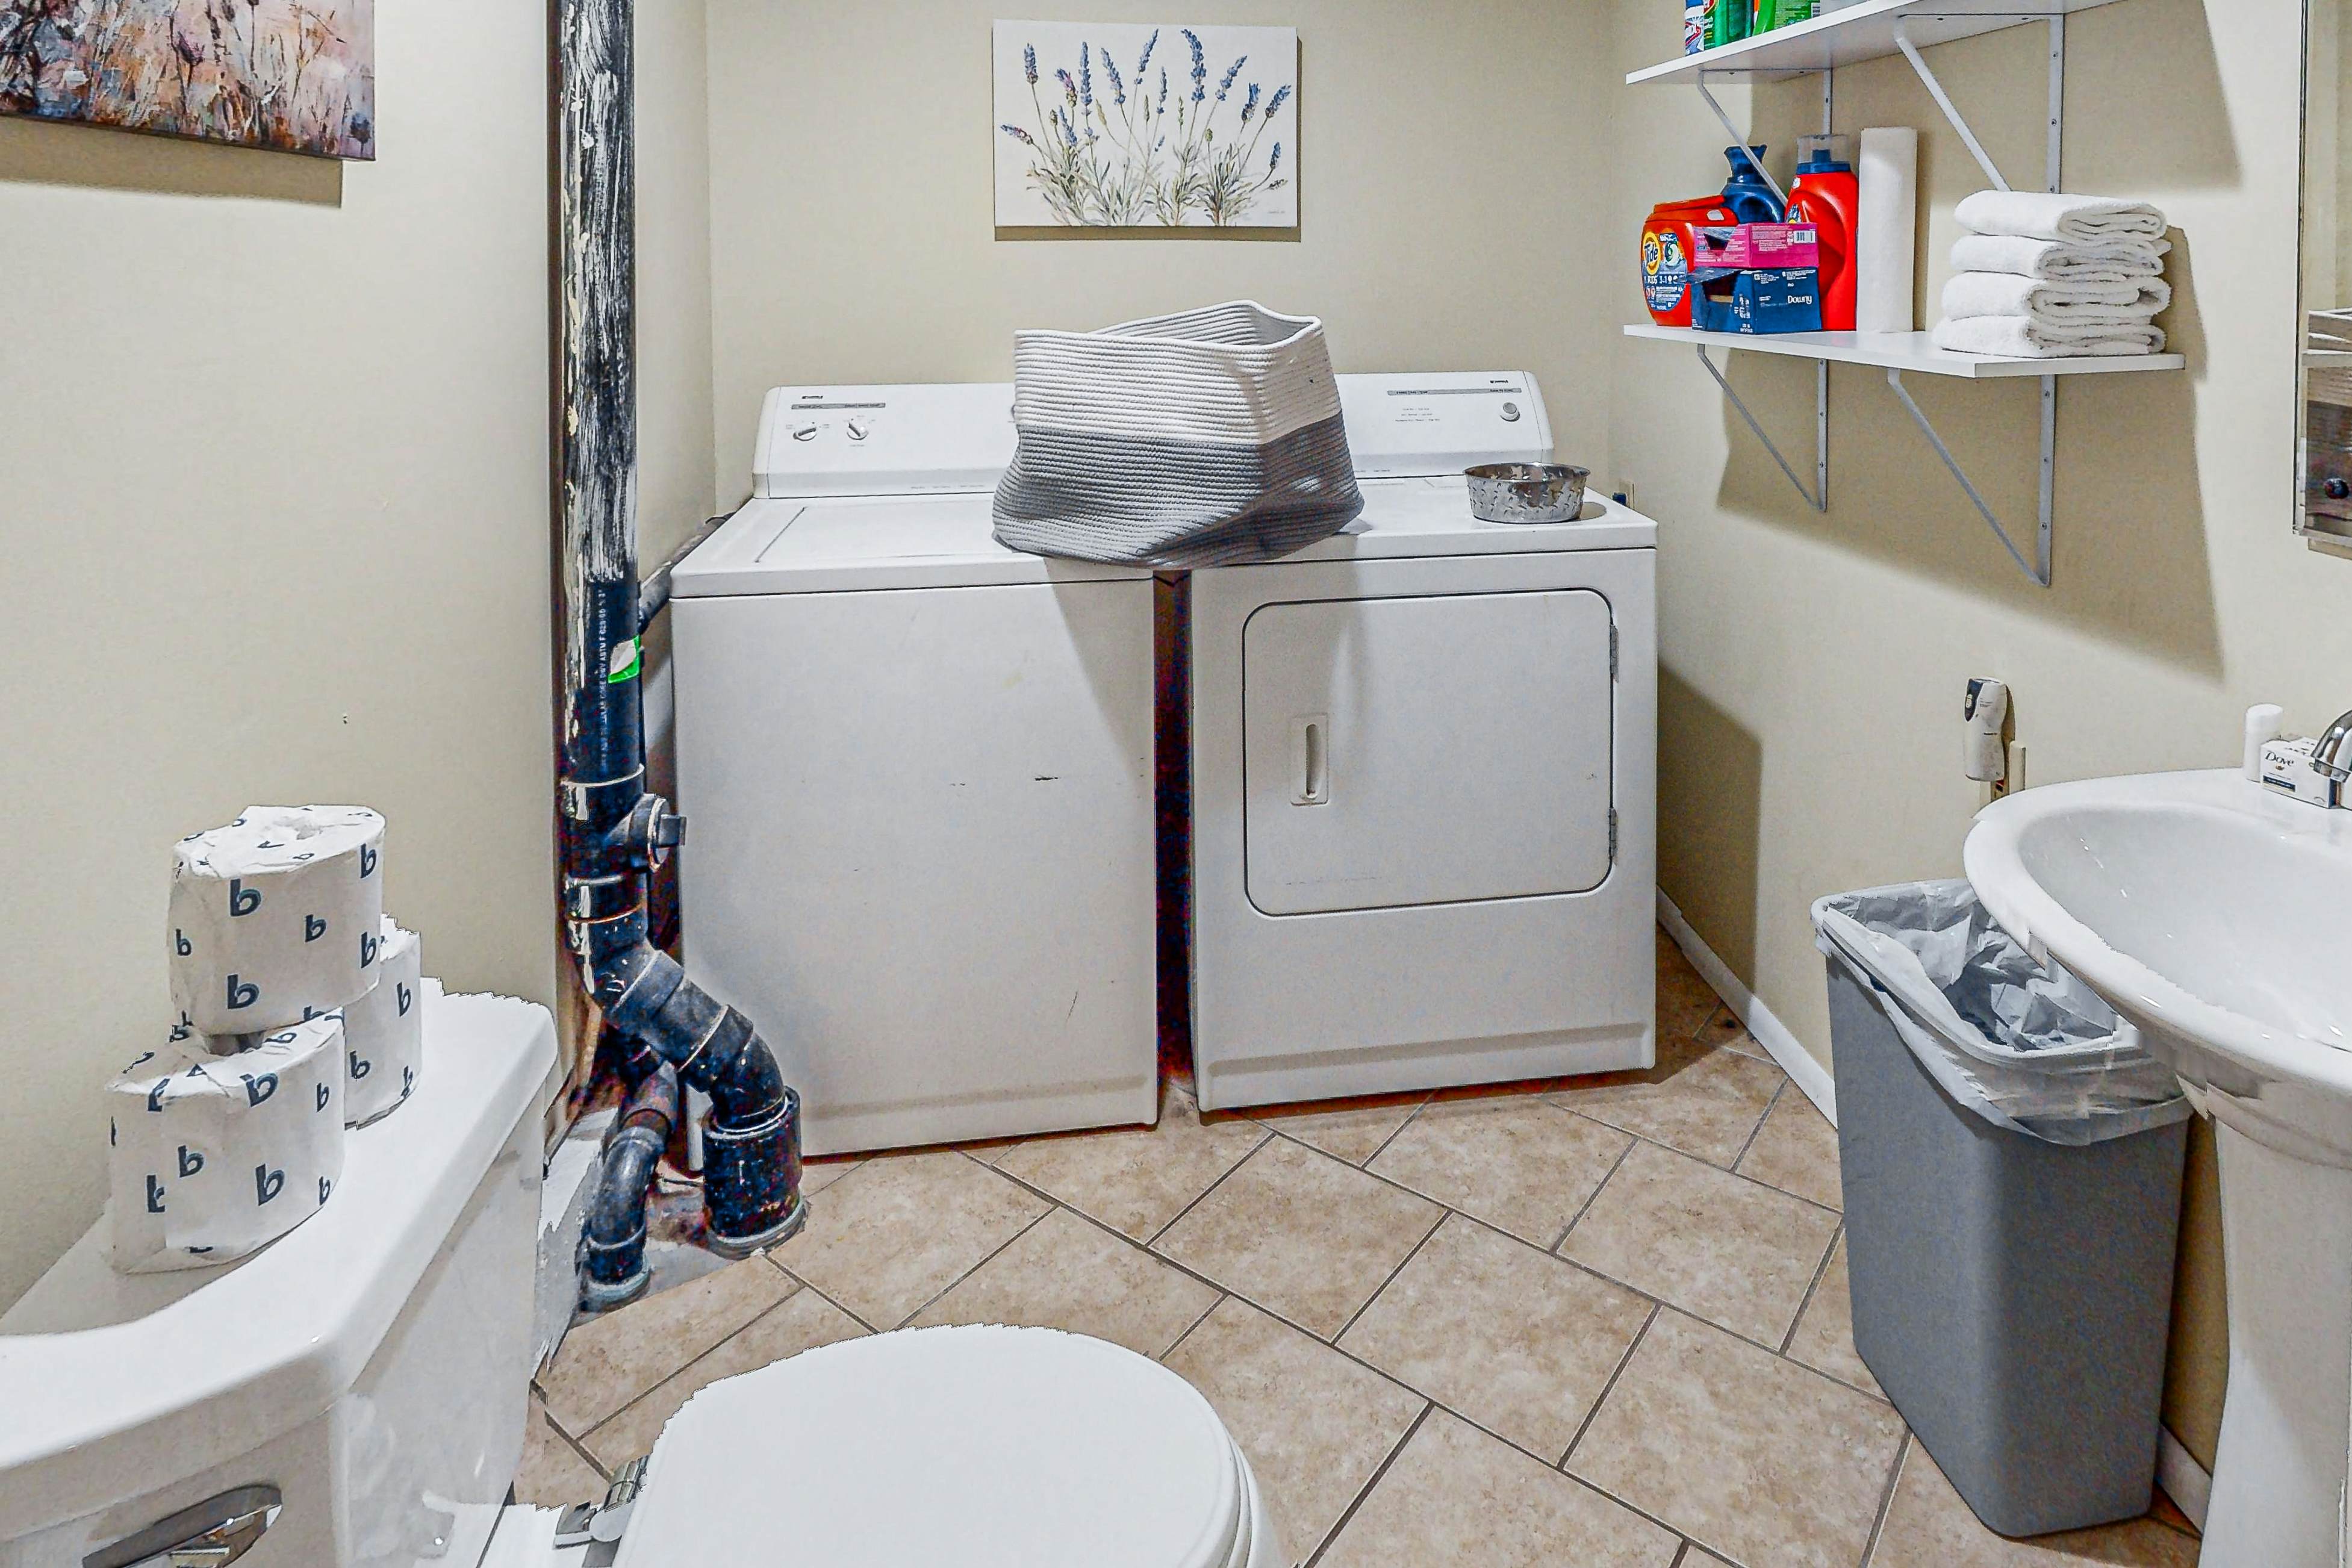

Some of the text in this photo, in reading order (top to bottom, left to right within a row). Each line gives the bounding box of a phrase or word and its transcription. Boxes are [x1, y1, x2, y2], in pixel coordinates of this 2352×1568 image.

[1643, 243, 1658, 266] Tide
[1787, 295, 1812, 305] Downy
[2265, 751, 2294, 767] Dove
[360, 843, 377, 879] b
[229, 878, 262, 917] b
[175, 928, 192, 956] b
[305, 913, 326, 943] b
[360, 932, 376, 969] b
[227, 974, 260, 1010] b
[396, 982, 411, 1017] b
[349, 1050, 370, 1080] b
[239, 1072, 278, 1107] b
[316, 1082, 329, 1112] b
[177, 1145, 204, 1178] b
[255, 1163, 285, 1207] b
[319, 1176, 331, 1206] b
